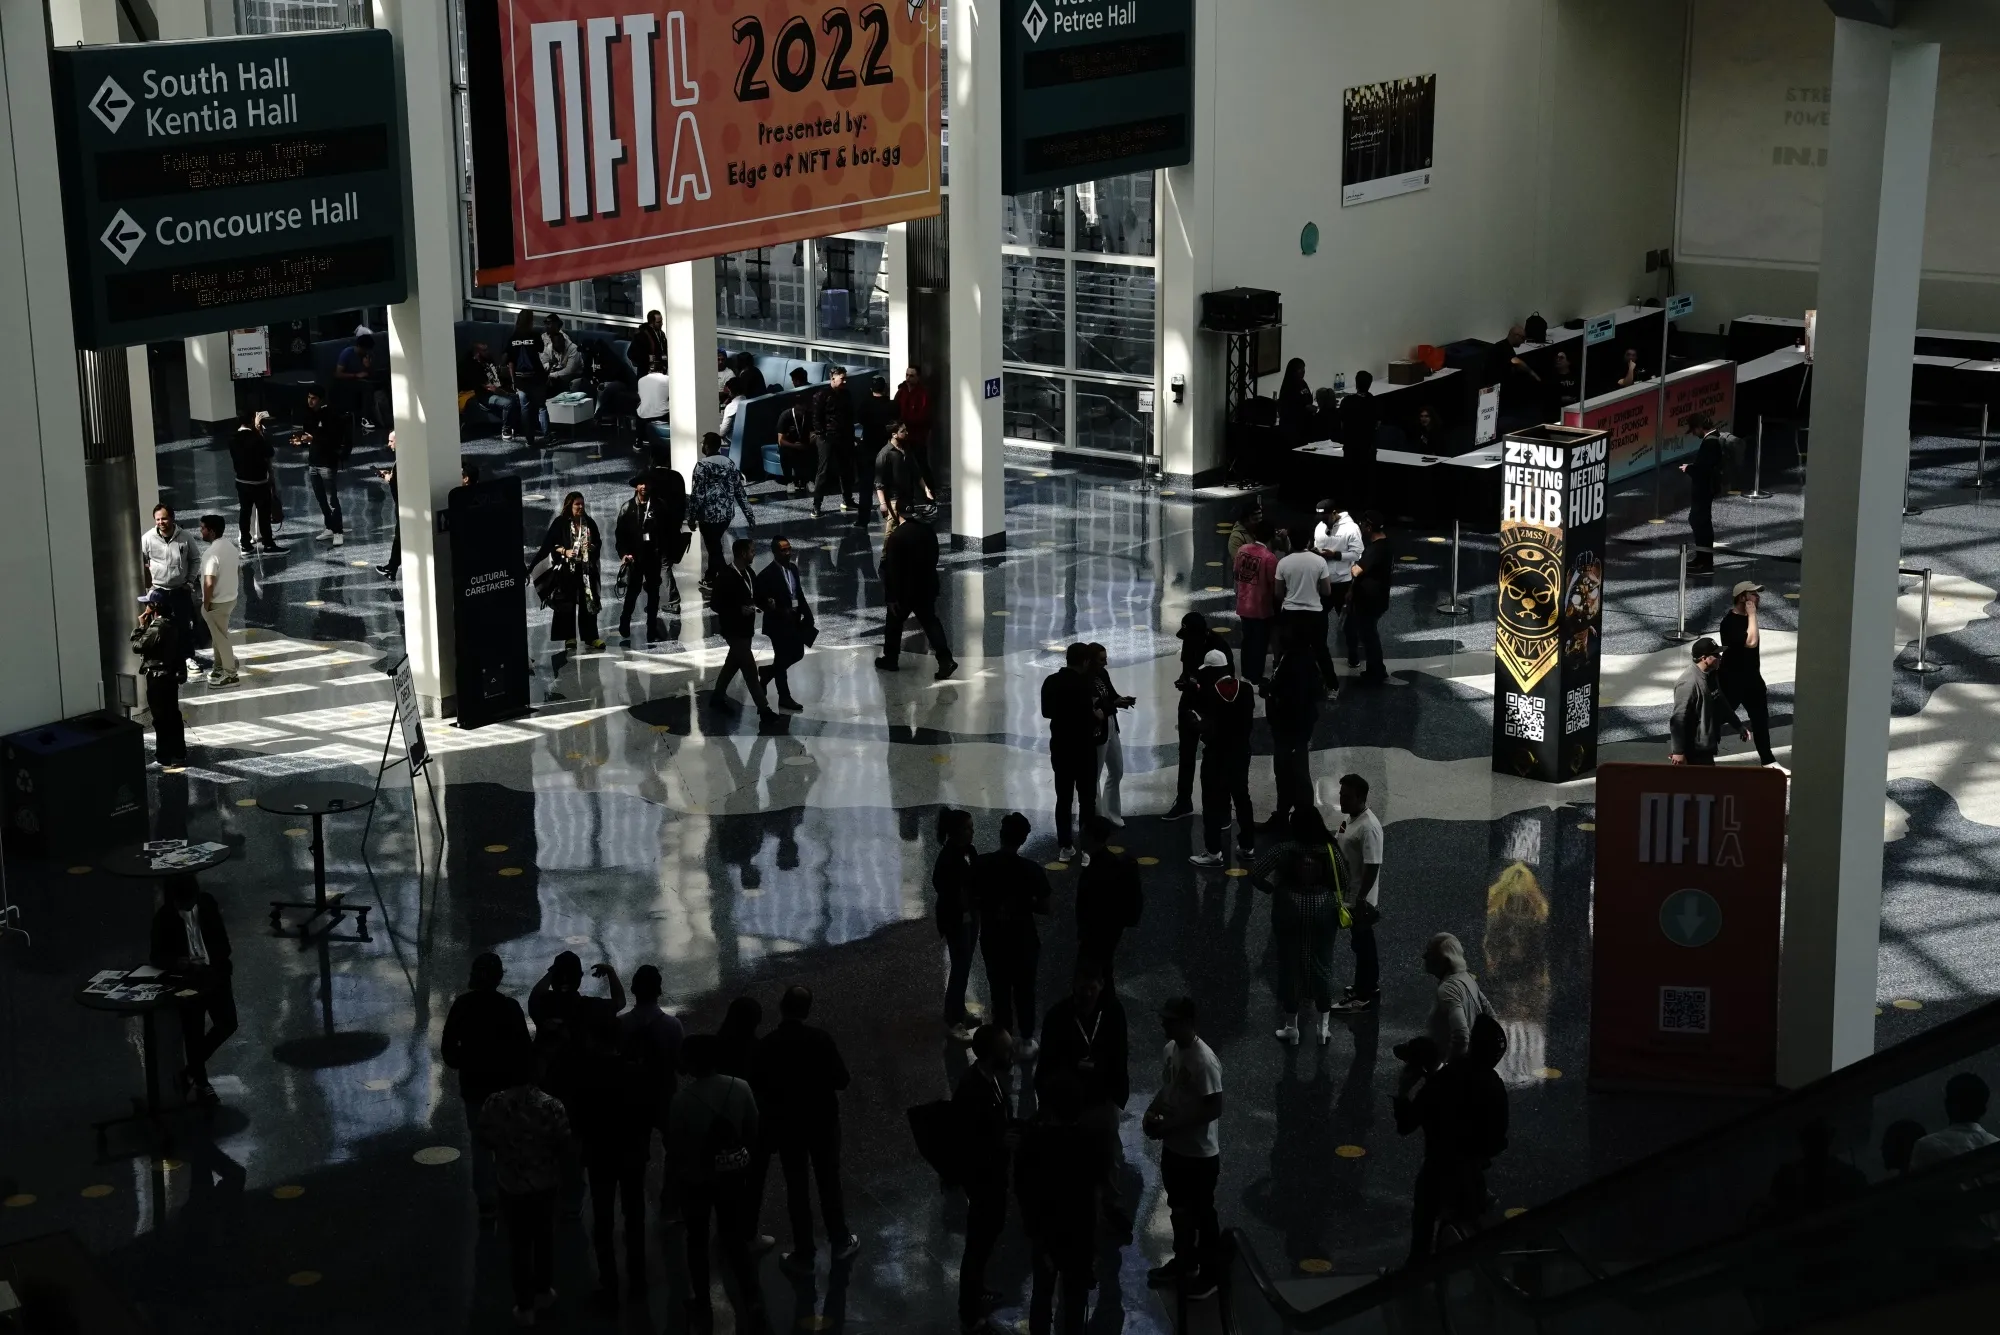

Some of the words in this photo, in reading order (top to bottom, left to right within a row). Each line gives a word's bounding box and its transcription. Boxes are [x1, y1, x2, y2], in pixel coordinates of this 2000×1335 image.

[1054, 10, 1103, 33] Petree
[1108, 1, 1136, 26] Hall
[732, 3, 893, 102] 2022
[143, 63, 228, 99] South
[238, 57, 289, 90] Hall
[1786, 86, 1831, 103] STRE
[146, 101, 237, 136] Kentia
[248, 93, 298, 127] Hall
[758, 110, 840, 145] Presented
[845, 112, 868, 137] by:
[1785, 110, 1830, 126] POWE
[162, 151, 209, 172] Follow
[218, 151, 237, 166] us
[246, 149, 263, 164] on
[271, 140, 328, 160] Twitter
[728, 161, 767, 189] Edge
[773, 153, 793, 178] of
[798, 148, 830, 174] NFT
[835, 146, 847, 169] &
[852, 142, 901, 169] bor.gg
[188, 160, 304, 188] @ConventionLA
[155, 206, 301, 246] Concourse
[310, 191, 359, 226] Hall
[172, 272, 218, 292] Follow
[227, 268, 245, 284] us
[254, 265, 272, 281] on
[281, 255, 335, 276] Twitter
[197, 275, 313, 306] @ConventionLA
[1621, 416, 1649, 434] SPONSOR
[1611, 432, 1639, 450] STRATION
[1505, 465, 1563, 490] MEETING
[1570, 462, 1605, 490] MEETING
[1504, 483, 1562, 528] HUB
[1569, 482, 1604, 528] HUB
[1520, 529, 1543, 540] ZMSS
[465, 578, 515, 597] CARETAKERS
[470, 570, 509, 585] CULTURAL
